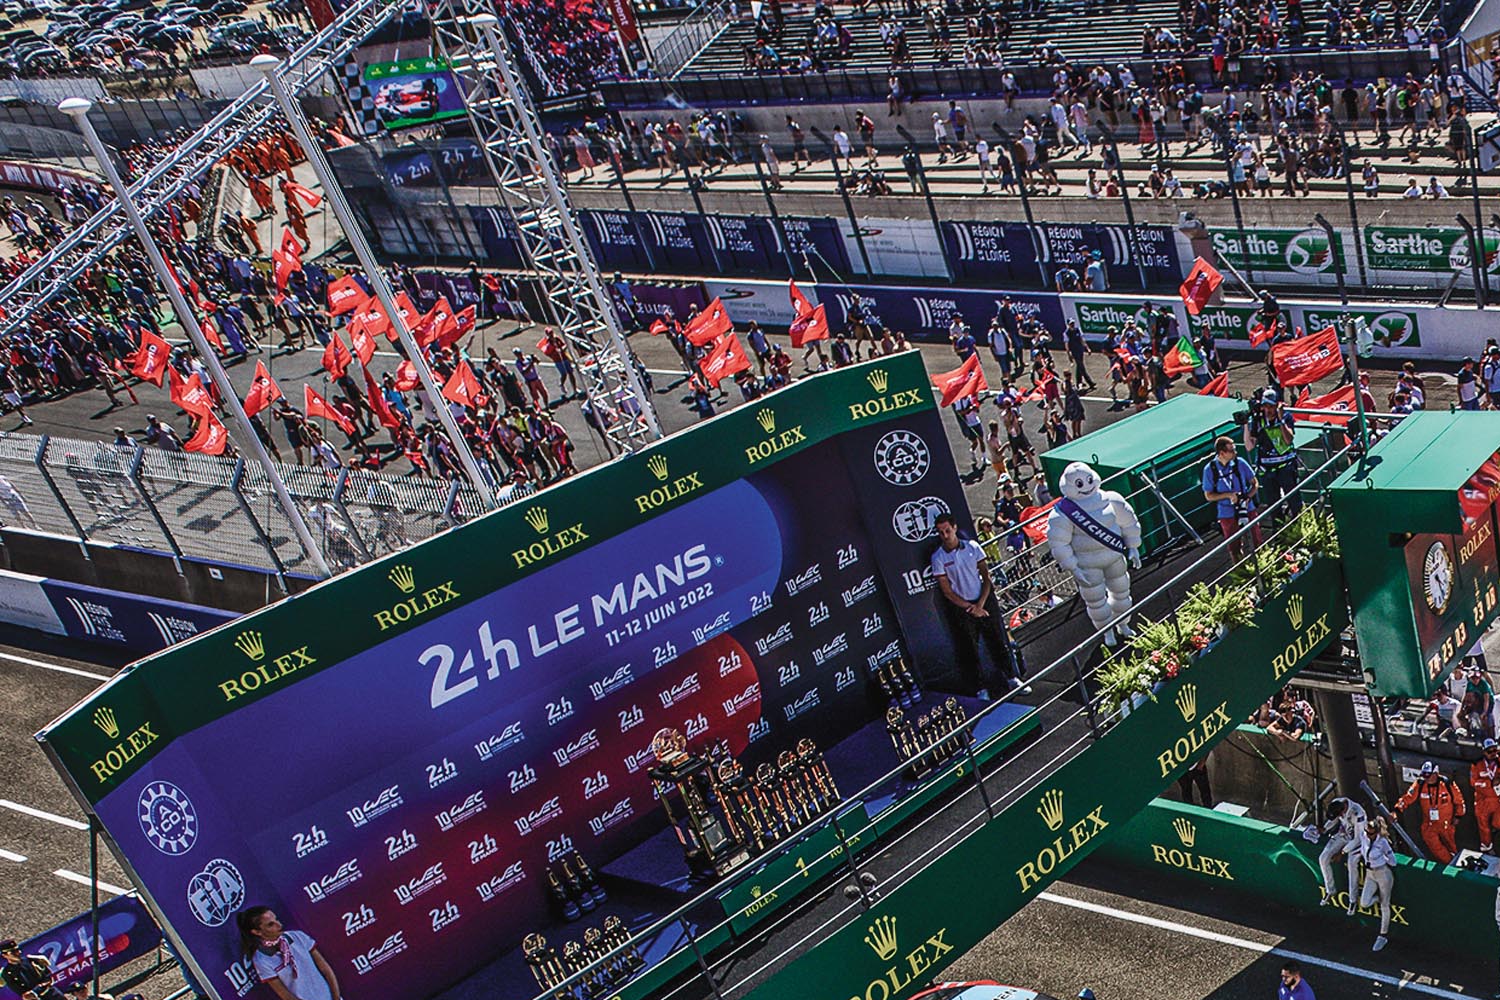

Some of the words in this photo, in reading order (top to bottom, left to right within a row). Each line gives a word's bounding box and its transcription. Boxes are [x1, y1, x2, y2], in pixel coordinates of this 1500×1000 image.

[974, 237, 998, 249] PAYS
[1048, 226, 1082, 239] RÉGION
[1050, 238, 1075, 250] PAYS
[1371, 230, 1443, 256] Sarthe
[1080, 305, 1127, 324] Sarthe
[1192, 310, 1241, 329] Sarthe
[849, 390, 922, 419] ROLEX
[746, 426, 806, 463] ROLEX
[636, 472, 704, 513] ROLEX
[513, 523, 588, 568] ROLEX
[1071, 510, 1127, 550] MICHELIN
[1460, 521, 1491, 565] ROLEX
[903, 570, 921, 590] 10
[374, 581, 459, 630] ROLEX
[605, 620, 641, 648] 11-12
[644, 601, 681, 636] JUIN
[679, 582, 714, 614] 2022
[418, 619, 521, 709] 24h
[528, 604, 585, 658] LE
[591, 543, 713, 628] MANS
[1273, 613, 1330, 680] ROLEX
[219, 647, 315, 700] ROLEX
[91, 722, 158, 782] ROLEX
[1158, 701, 1230, 777] ROLEX
[955, 763, 966, 778] 3
[1016, 805, 1108, 893] ROLEX
[1151, 844, 1234, 881] ROLEX
[50, 974, 67, 986] LE
[224, 961, 249, 991] 10
